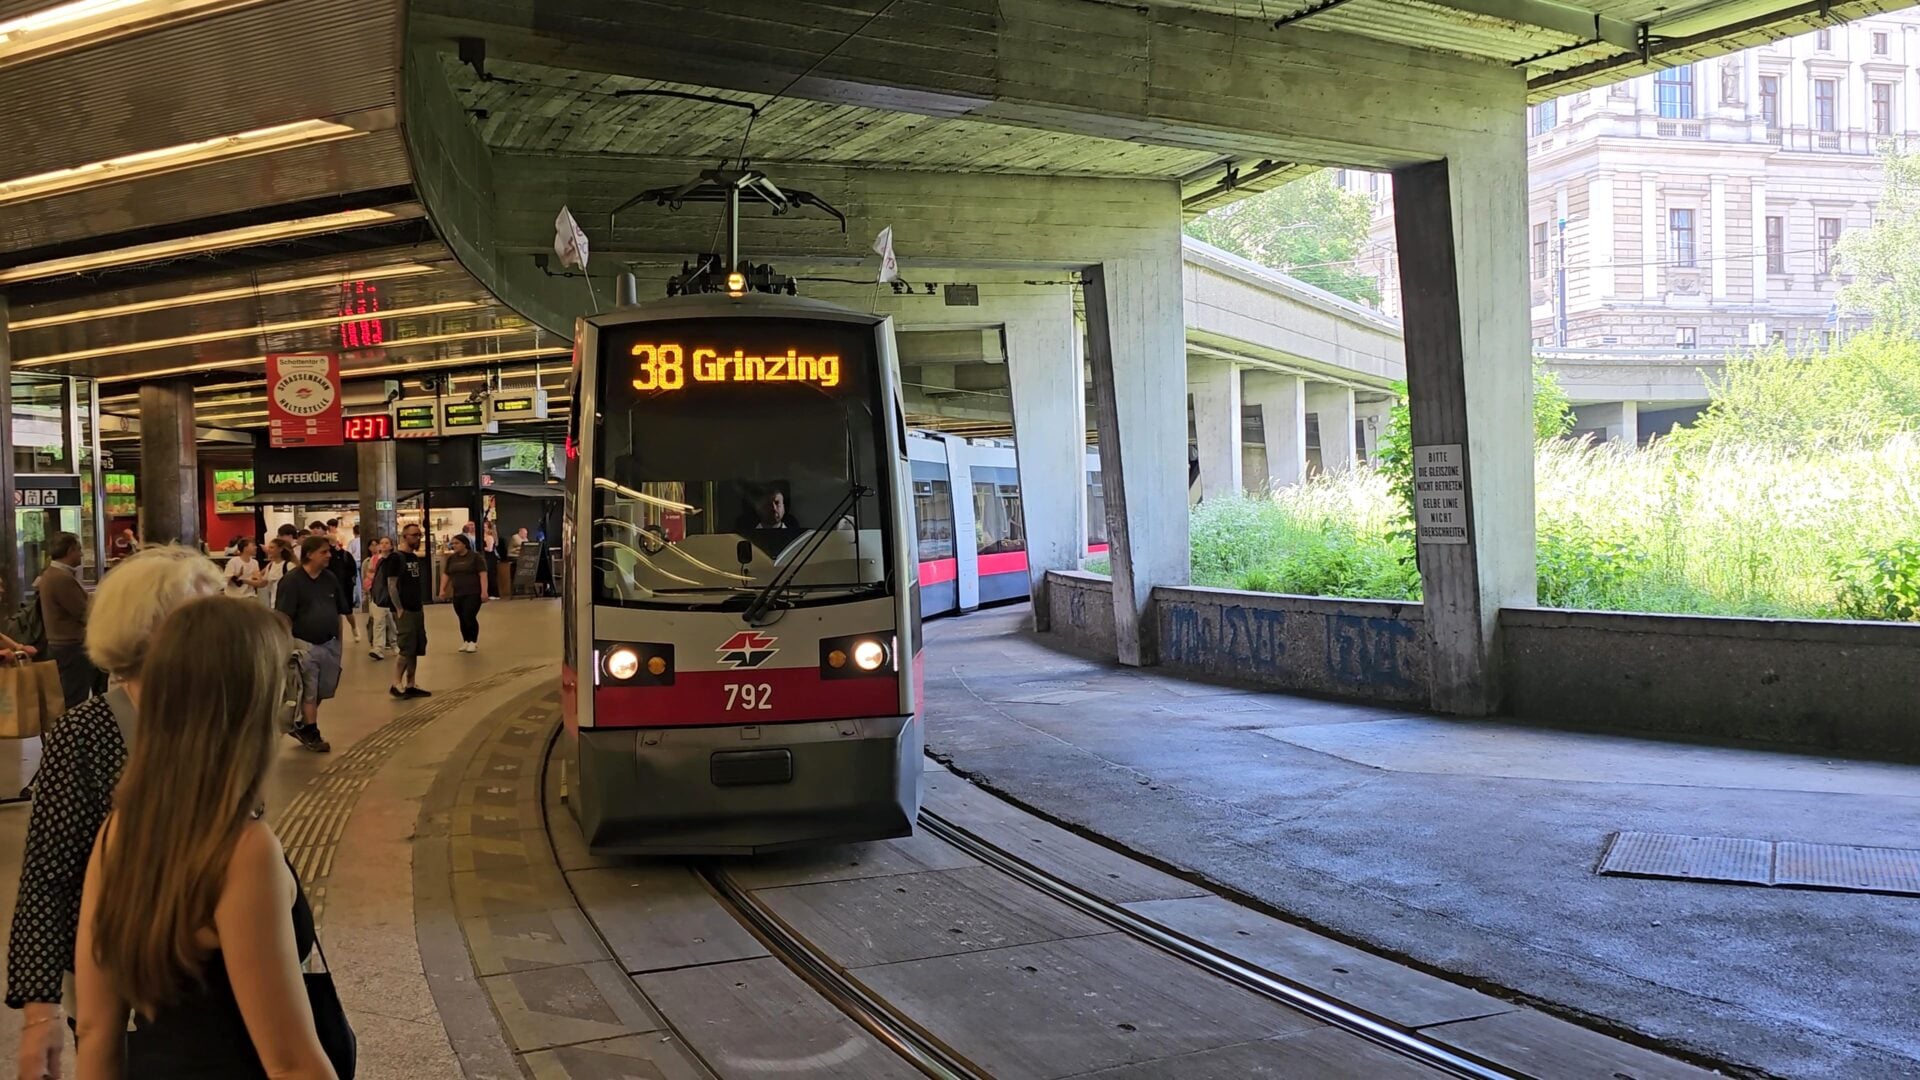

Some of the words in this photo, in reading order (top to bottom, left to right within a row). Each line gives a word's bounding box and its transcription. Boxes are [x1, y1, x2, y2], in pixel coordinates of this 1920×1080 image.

[631, 344, 684, 390] 38
[692, 349, 839, 387] Grinzing
[278, 374, 330, 391] STRASSENBAHN
[280, 398, 329, 414] HALTESTELLE
[1428, 452, 1448, 462] BITTE
[1418, 466, 1428, 477] DIE
[1429, 465, 1460, 477] GLEISZONE
[267, 471, 339, 484] KAFFEEKÜCHE
[1417, 481, 1433, 491] NICHT
[1435, 480, 1463, 491] BETRETEN
[1423, 498, 1441, 509] GELBE
[1443, 498, 1458, 509] LINIE
[1430, 512, 1452, 522] NICHT
[1421, 525, 1465, 537] ÜBERSCHREITEN
[724, 683, 772, 711] 792
